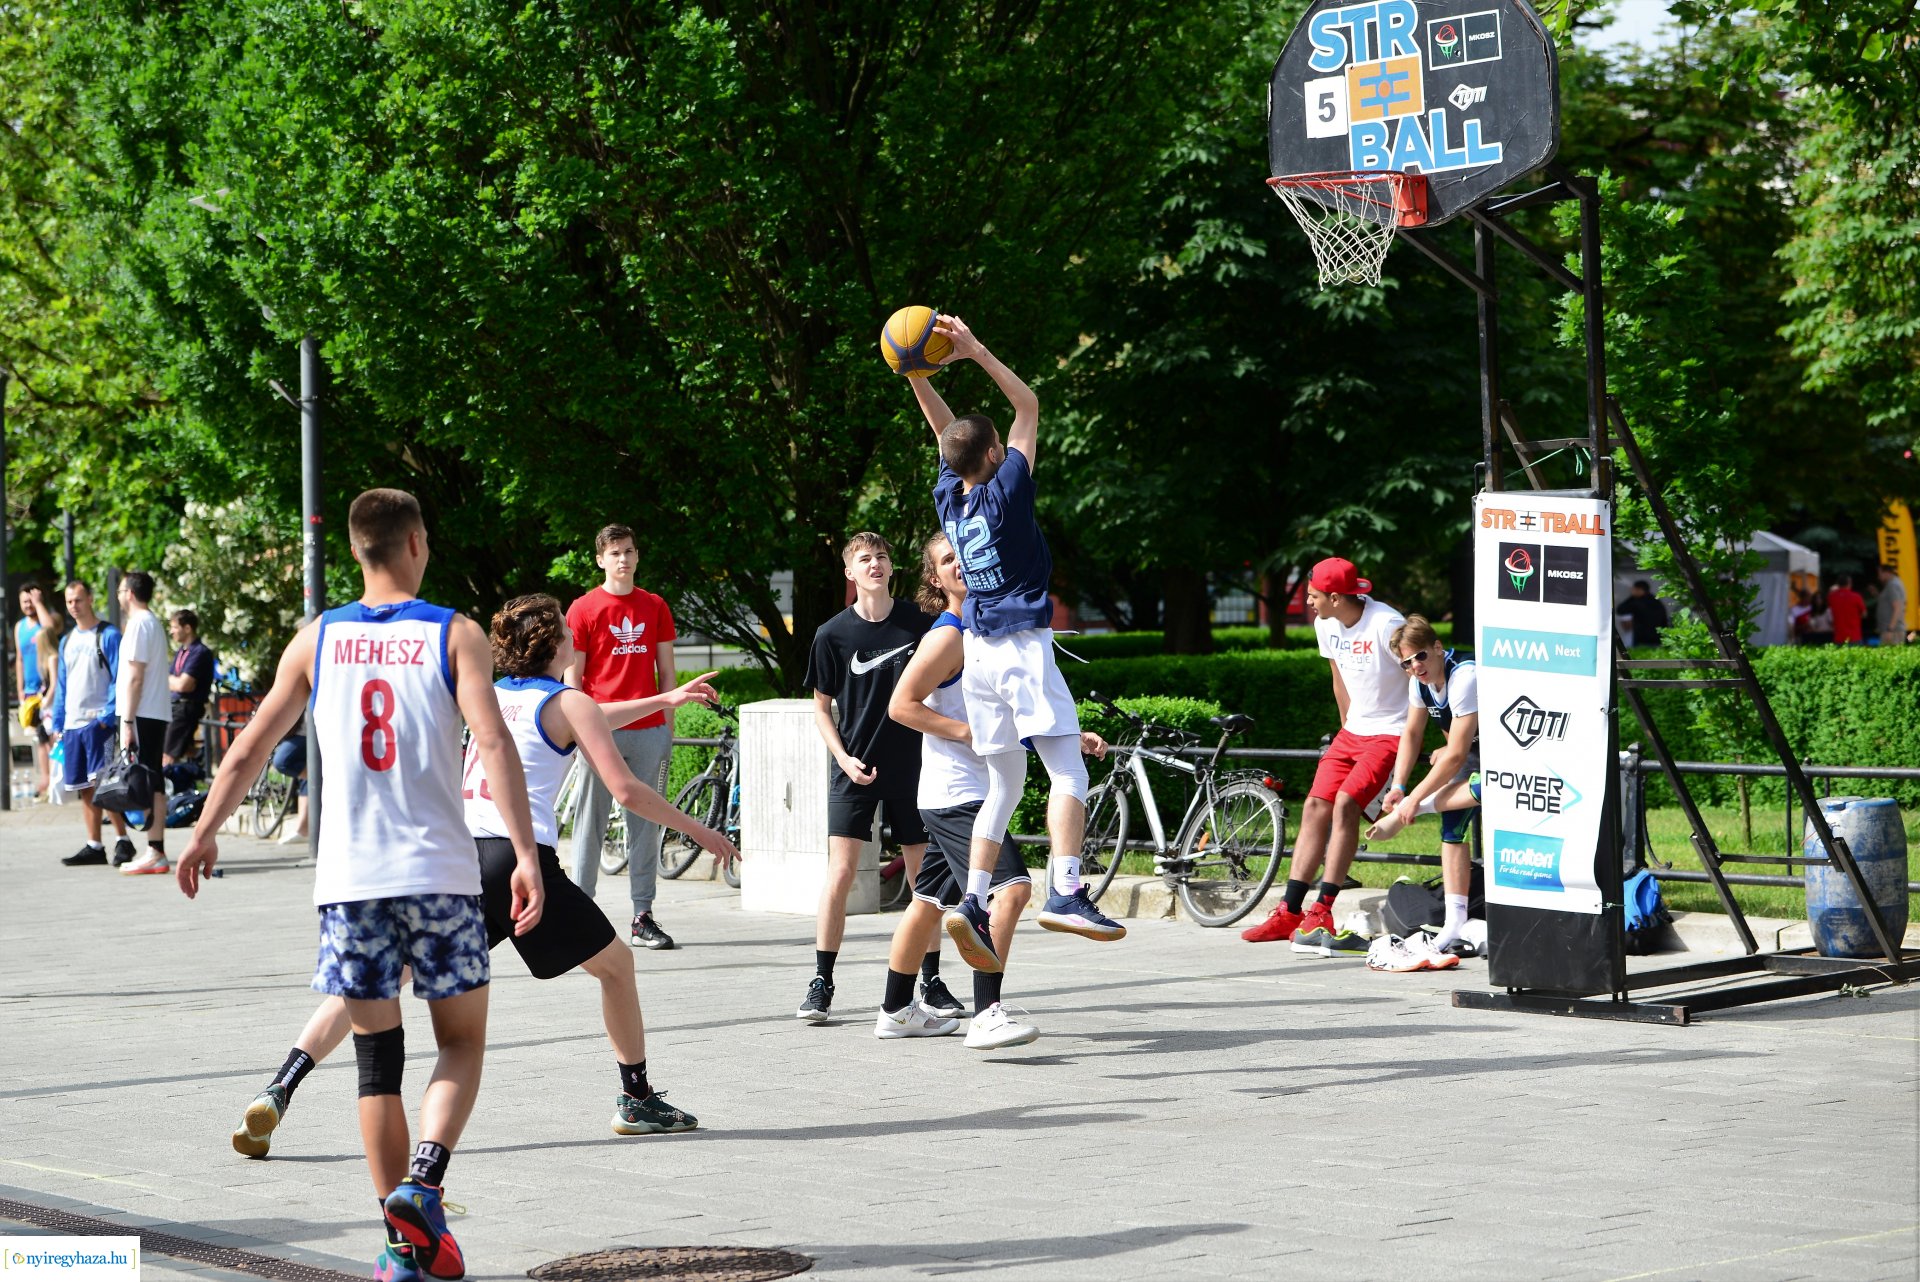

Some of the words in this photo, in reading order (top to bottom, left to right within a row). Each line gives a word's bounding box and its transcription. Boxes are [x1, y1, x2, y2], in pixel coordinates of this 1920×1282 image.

[1318, 91, 1337, 123] 5
[1350, 108, 1502, 179] BALL
[1547, 569, 1584, 580] MKOSZ
[334, 633, 425, 666] MÉHÉSZ
[612, 643, 648, 656] adidas
[1491, 638, 1550, 662] MVM
[1555, 644, 1581, 658] Next
[361, 678, 397, 772] 8
[1516, 707, 1571, 741] TOTI
[1485, 770, 1564, 796] POWER
[1515, 793, 1561, 814] ADE
[1500, 847, 1554, 869] molten
